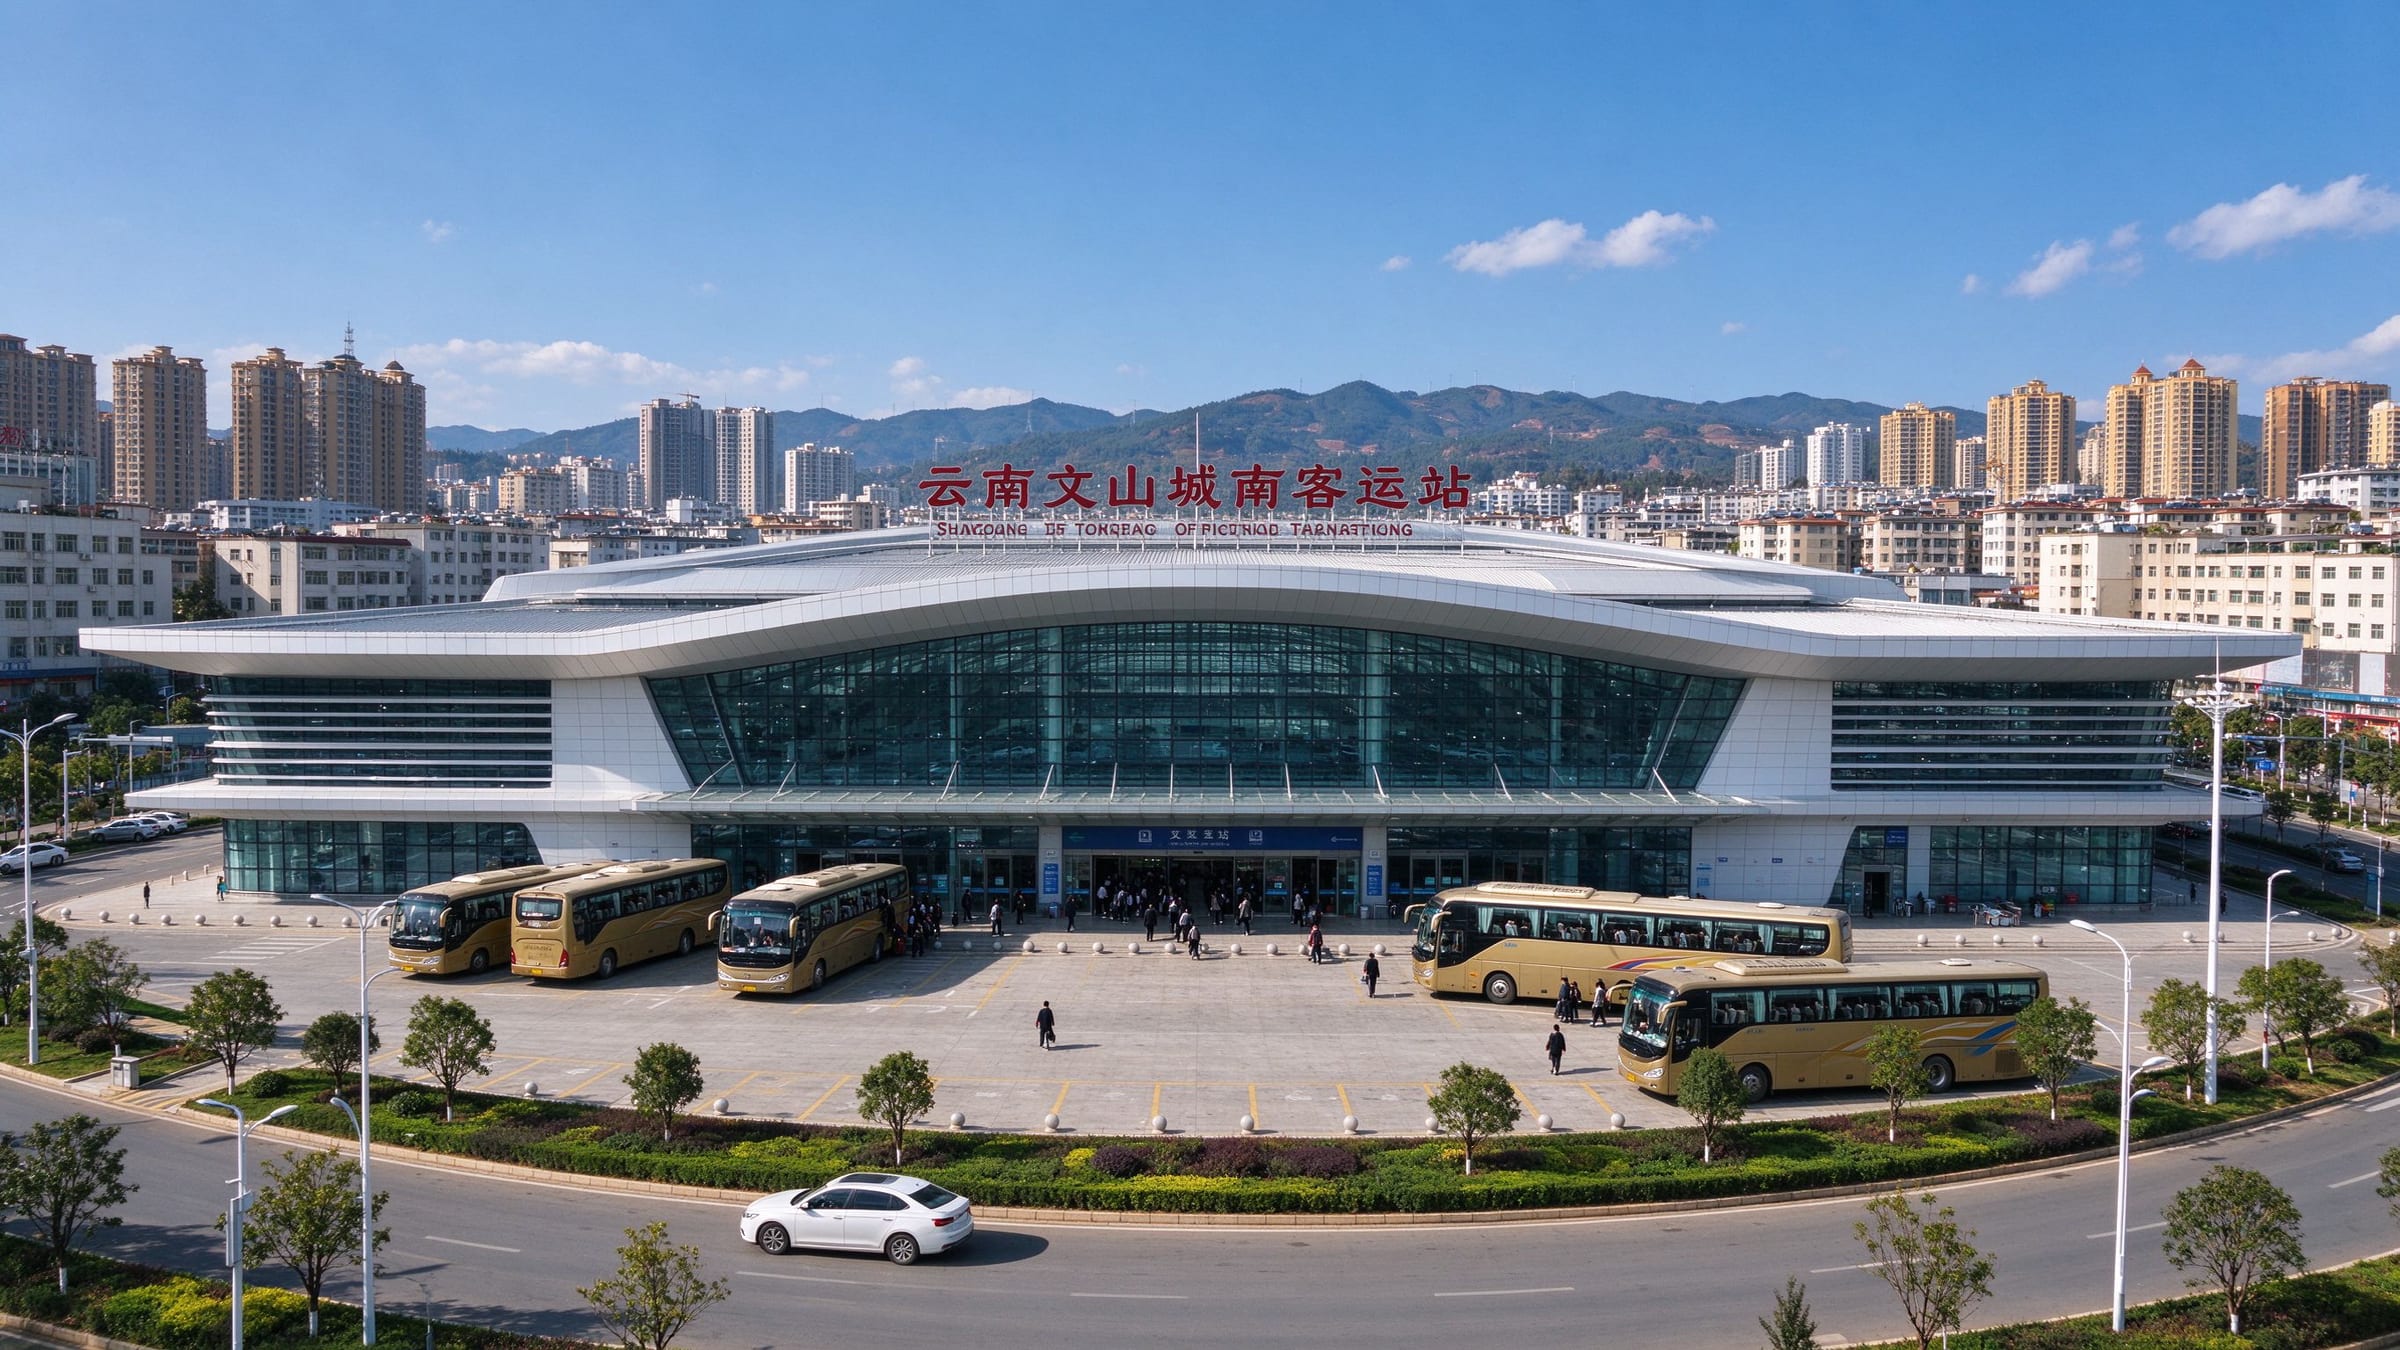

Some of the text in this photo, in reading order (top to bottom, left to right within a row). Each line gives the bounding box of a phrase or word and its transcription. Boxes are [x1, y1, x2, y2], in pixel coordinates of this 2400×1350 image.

[918, 463, 1472, 510] 云南文山城南客运站
